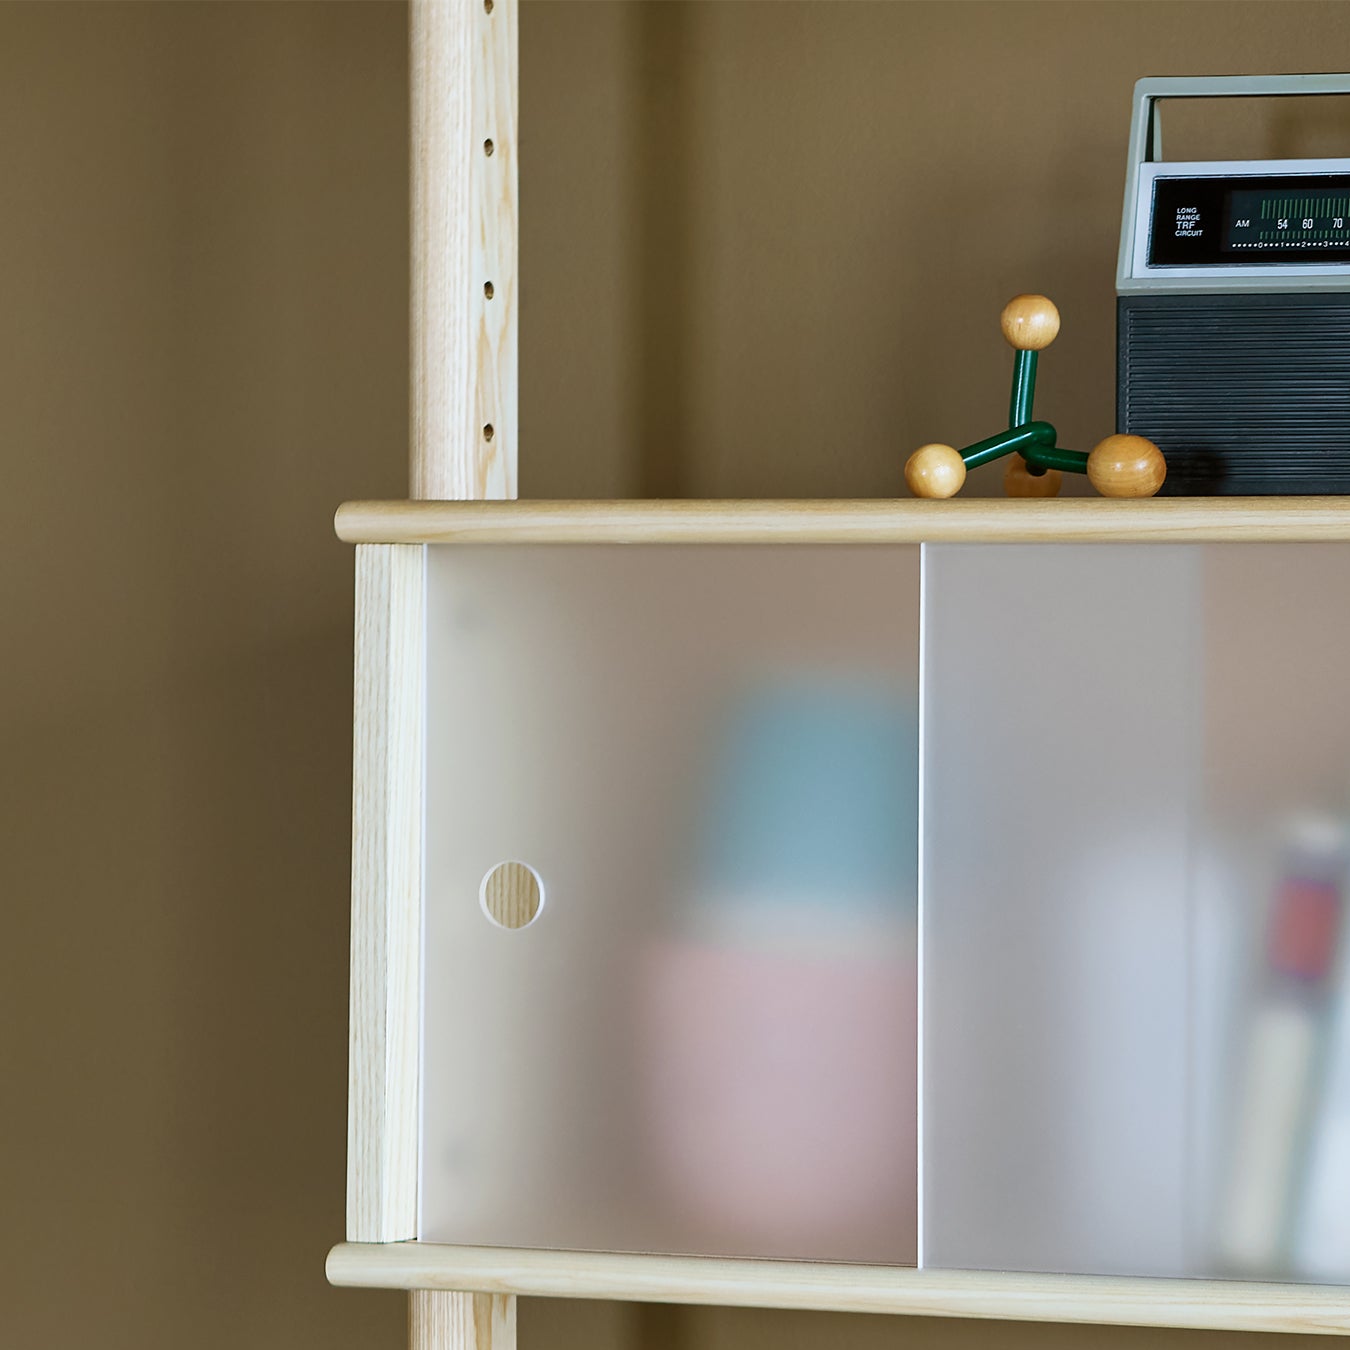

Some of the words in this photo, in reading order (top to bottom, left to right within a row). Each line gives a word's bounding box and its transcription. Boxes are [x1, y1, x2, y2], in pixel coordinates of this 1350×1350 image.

[1176, 221, 1196, 230] TRF
[1235, 220, 1250, 228] AM
[1277, 218, 1288, 229] 54
[1302, 218, 1313, 229] 60
[1332, 217, 1343, 229] 70
[1175, 229, 1203, 237] CIRCUIT
